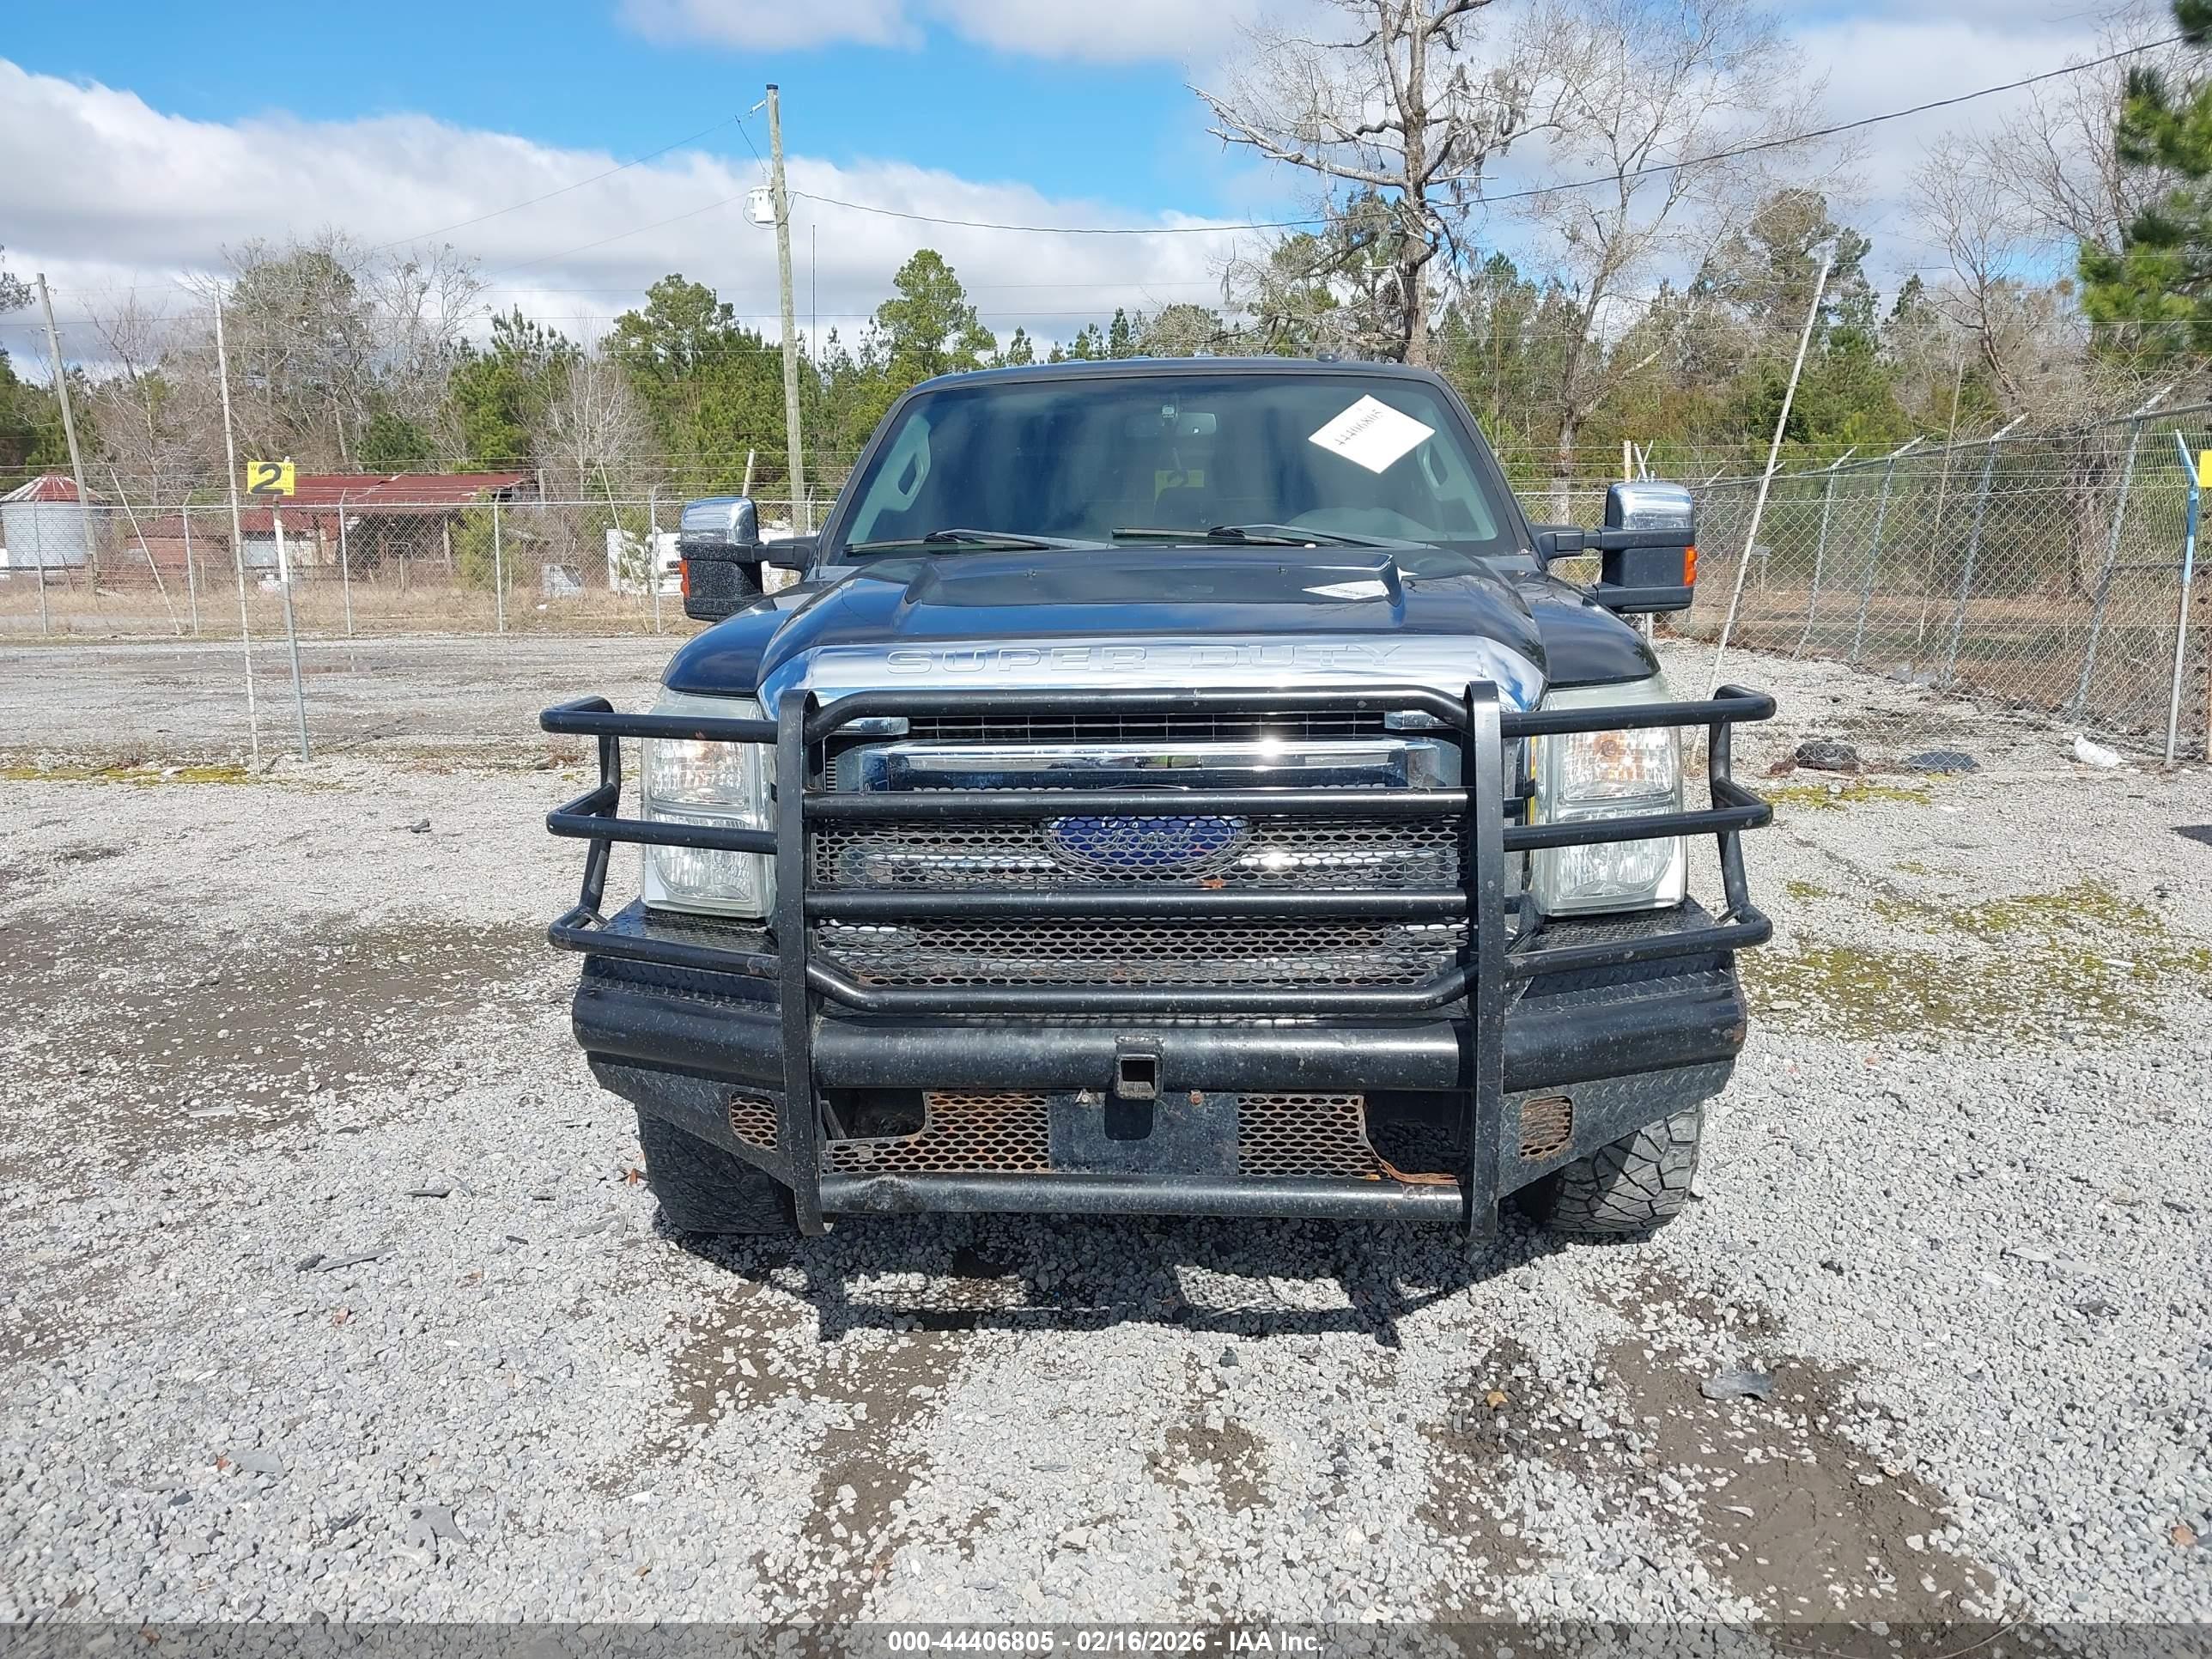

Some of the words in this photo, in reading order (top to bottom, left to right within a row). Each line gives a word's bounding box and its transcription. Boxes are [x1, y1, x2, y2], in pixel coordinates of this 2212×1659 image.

[250, 463, 284, 495] 2
[885, 646, 1148, 674] SUPER
[1188, 644, 1403, 669] DUTY
